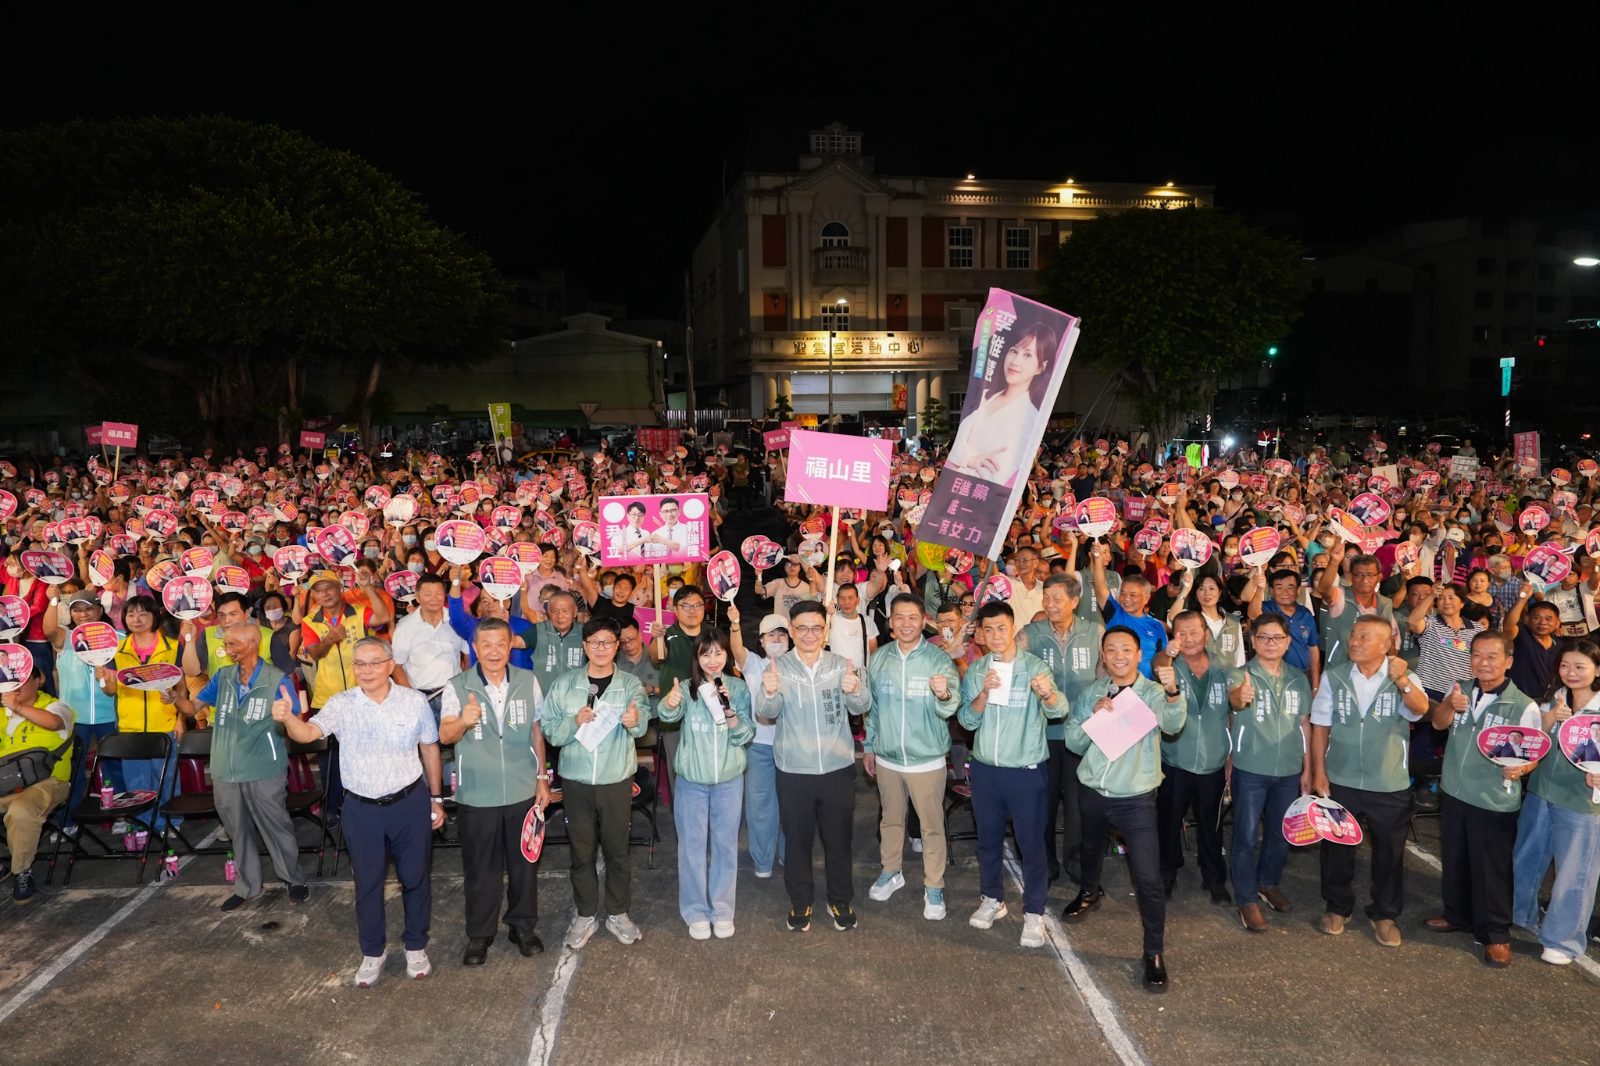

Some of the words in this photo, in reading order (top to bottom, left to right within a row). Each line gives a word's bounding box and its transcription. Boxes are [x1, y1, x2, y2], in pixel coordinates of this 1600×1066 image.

[805, 456, 872, 483] 福山里
[605, 524, 622, 559] 尹立
[1488, 732, 1508, 740] 南方
[1569, 725, 1590, 735] 南方
